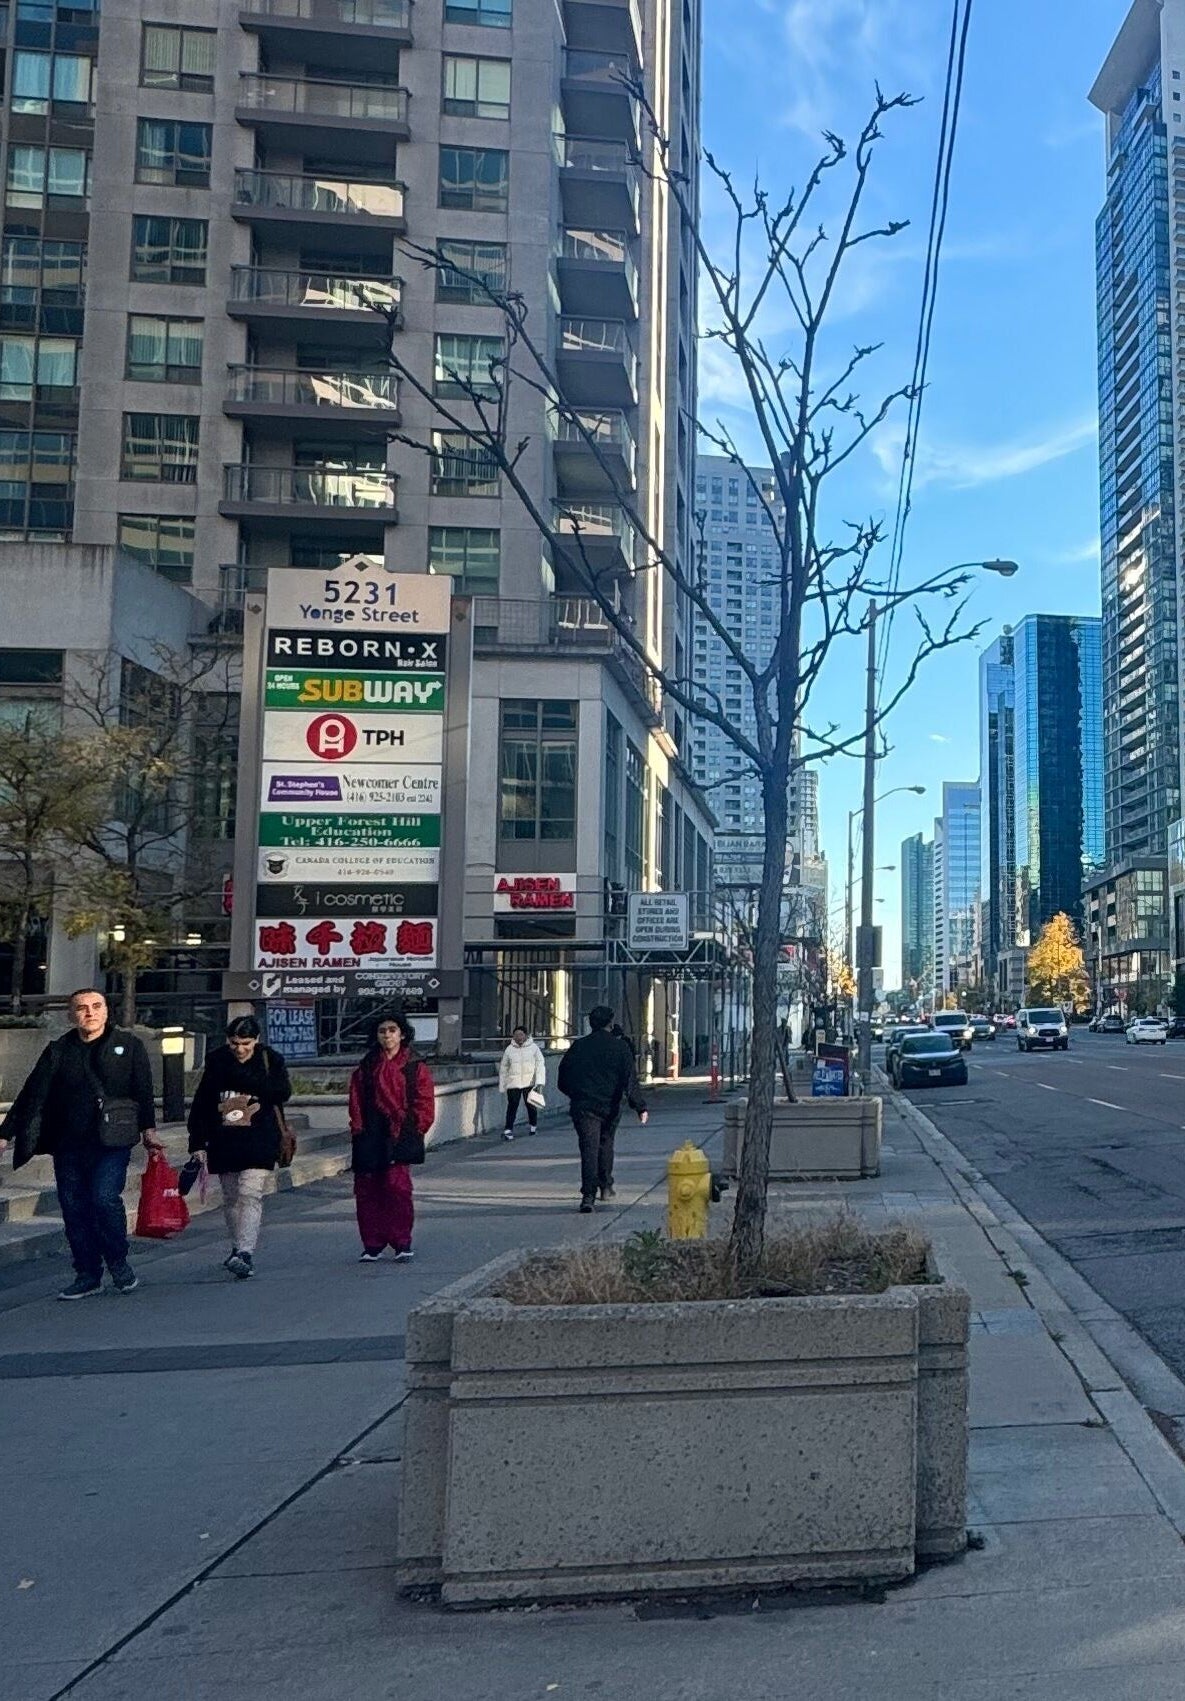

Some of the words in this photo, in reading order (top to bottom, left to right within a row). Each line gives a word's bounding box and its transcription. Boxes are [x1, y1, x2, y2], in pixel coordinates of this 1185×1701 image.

[324, 580, 397, 606] 5231
[300, 604, 355, 624] Yonge
[361, 606, 419, 624] Street
[274, 674, 293, 682] OPEN
[297, 679, 442, 704] SUBWAY
[362, 729, 405, 746] TPH
[343, 774, 400, 789] Newcomer
[402, 775, 439, 790] Centre
[282, 816, 332, 827] Upper
[338, 816, 387, 826] Forest
[392, 817, 421, 826] Hill
[311, 826, 392, 837] Education
[280, 837, 310, 846] Tel:
[314, 837, 421, 847] 416-250-6666
[496, 877, 561, 893] AJISEN
[510, 892, 574, 909] RAMEN
[258, 957, 308, 969] AJISEN
[312, 957, 361, 968] RAMEN
[285, 975, 323, 984] Leased
[324, 976, 345, 984] and
[283, 986, 331, 995] managed
[333, 985, 346, 995] by
[268, 1009, 287, 1025] FOR
[288, 1009, 315, 1025] LEASE
